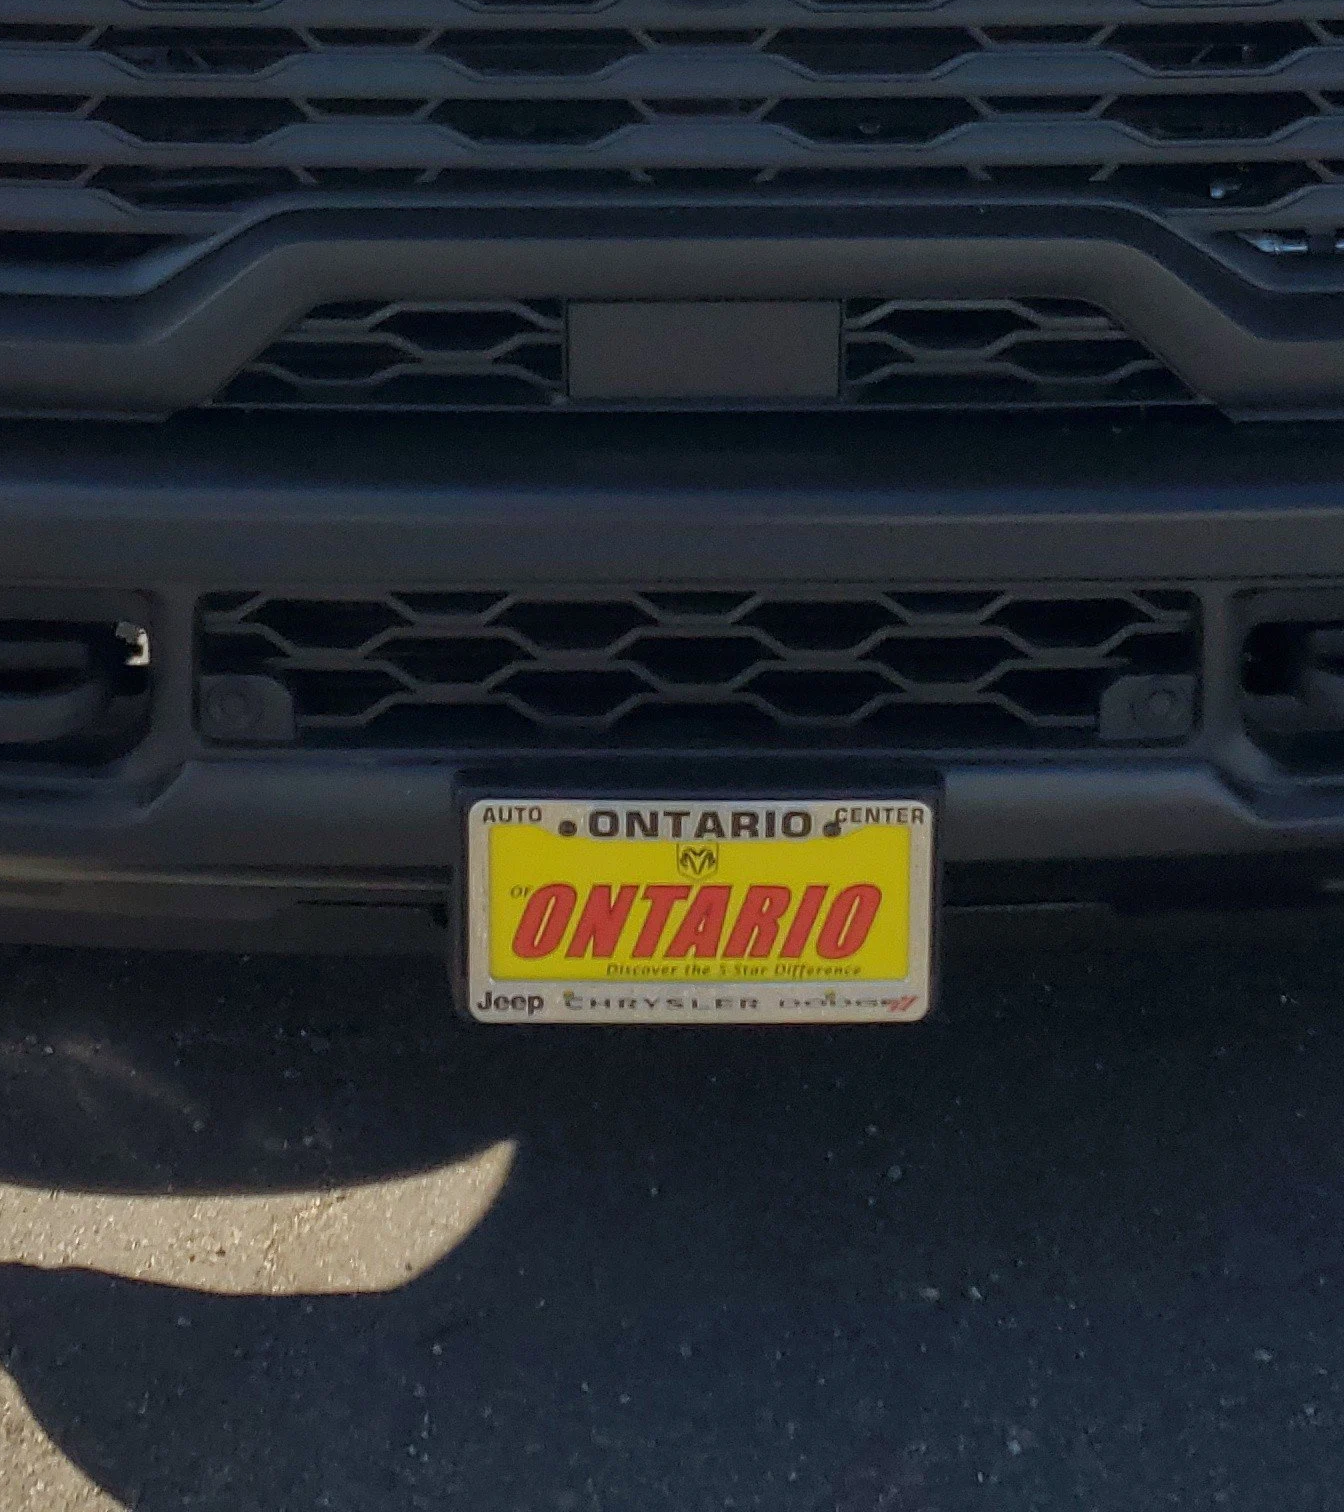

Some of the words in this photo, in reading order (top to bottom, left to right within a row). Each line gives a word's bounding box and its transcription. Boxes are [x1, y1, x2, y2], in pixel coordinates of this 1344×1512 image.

[483, 806, 543, 824] AUTO
[588, 809, 812, 839] ONTARIO
[835, 807, 925, 825] CENTER
[511, 883, 883, 959] ONTARIO
[606, 963, 678, 976] Discover
[684, 963, 711, 976] the
[734, 963, 768, 976] Star
[774, 962, 862, 979] Difference
[476, 990, 545, 1015] Jeep
[565, 995, 759, 1011] CHRYSLER
